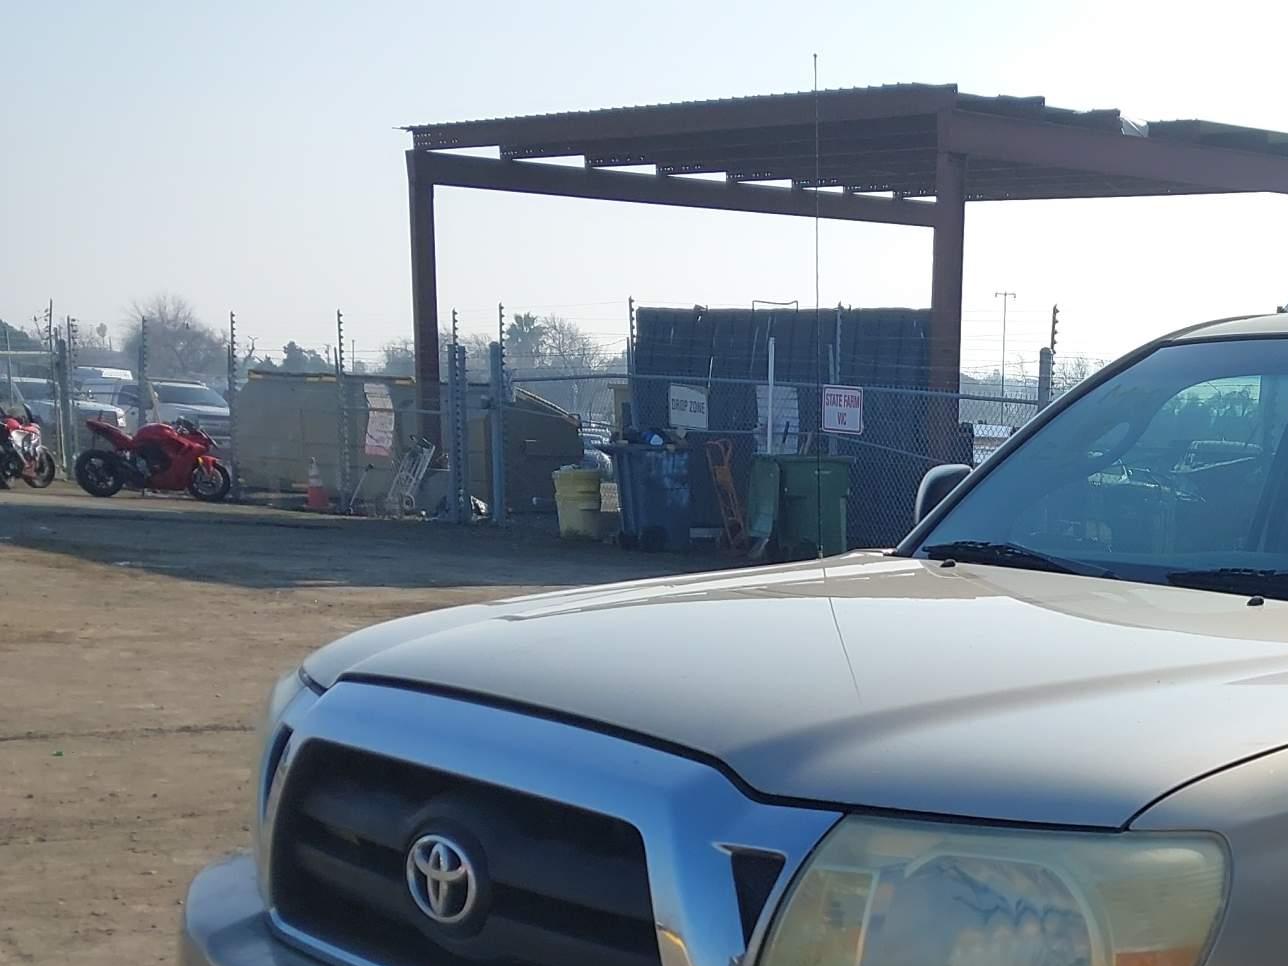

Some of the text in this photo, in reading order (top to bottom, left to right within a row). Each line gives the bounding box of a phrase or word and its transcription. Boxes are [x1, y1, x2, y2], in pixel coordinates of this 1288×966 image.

[671, 398, 705, 414] DROP ZONE
[826, 392, 860, 409] STATE FARM
